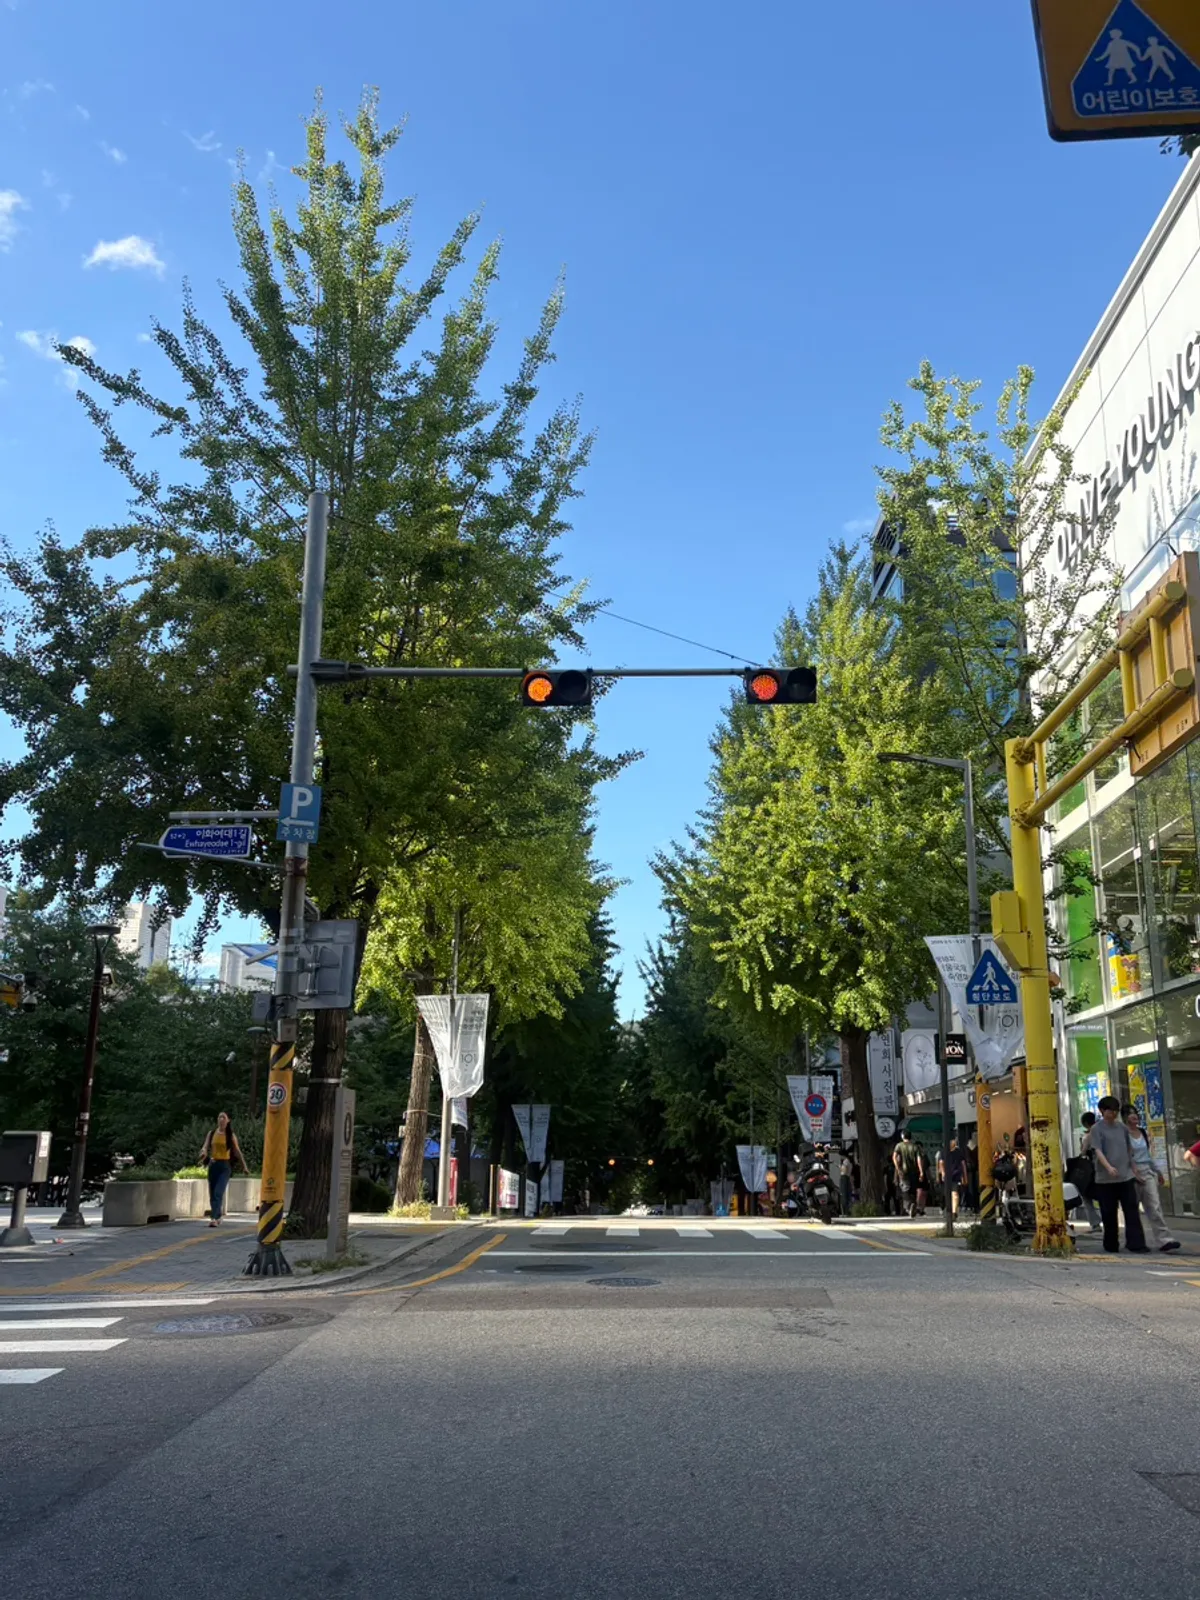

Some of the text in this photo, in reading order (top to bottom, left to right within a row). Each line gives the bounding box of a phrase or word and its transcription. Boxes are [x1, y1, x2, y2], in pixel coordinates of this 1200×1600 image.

[1082, 86, 1200, 112] 어린이보호
[291, 786, 314, 819] P
[971, 992, 1012, 1002] 횡단보도
[269, 1089, 283, 1100] 30
